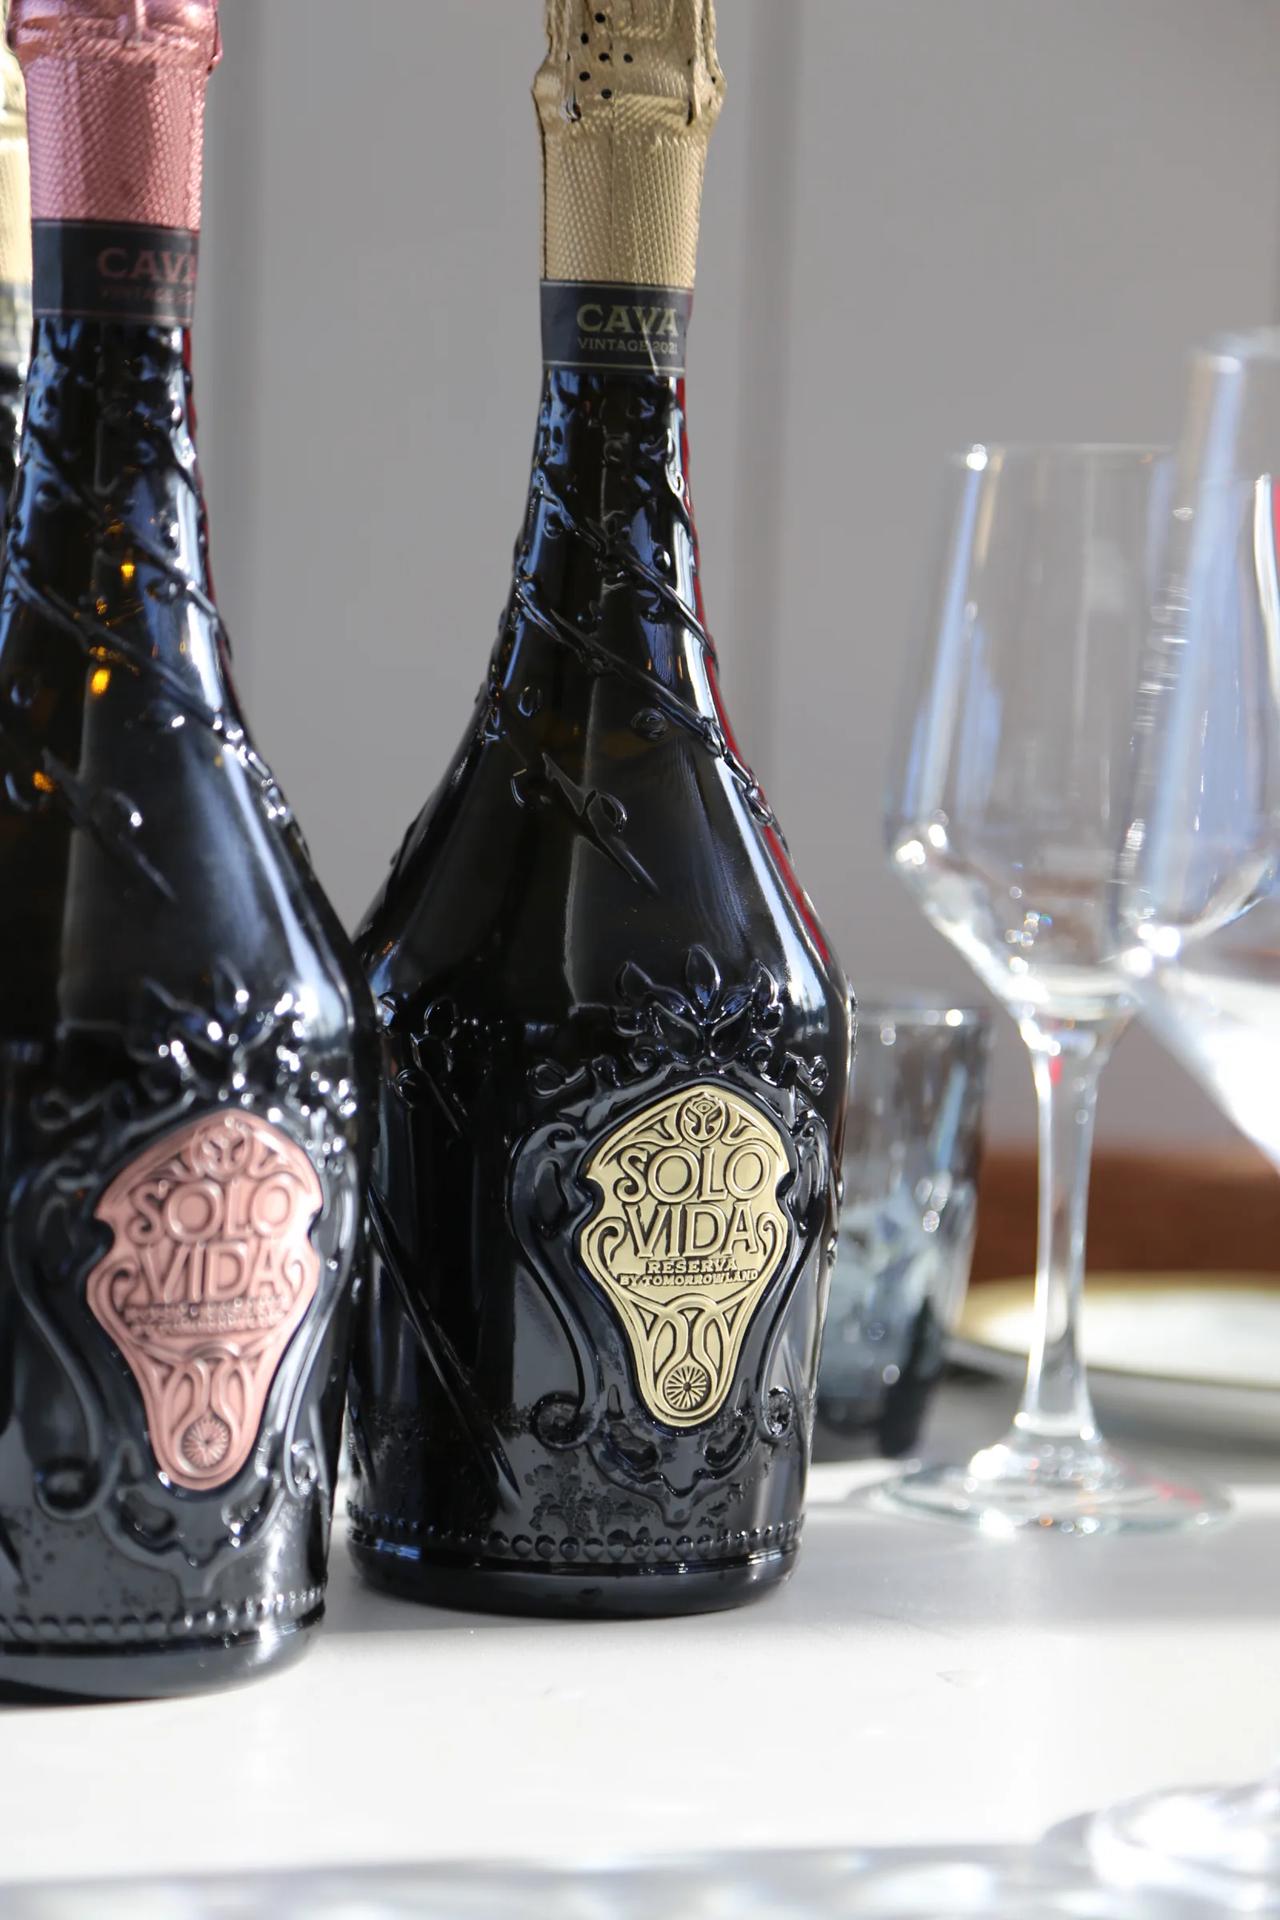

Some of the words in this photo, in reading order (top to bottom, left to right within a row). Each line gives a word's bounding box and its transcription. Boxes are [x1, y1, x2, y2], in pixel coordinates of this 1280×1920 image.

[577, 303, 679, 337] CAVA
[577, 336, 649, 353] VINTAGE
[613, 1143, 770, 1203] SOLO
[127, 1172, 297, 1245] SOLO
[624, 1200, 760, 1258] VIDA
[136, 1239, 289, 1303] VIDA
[640, 1269, 759, 1288] TOMORROWLAND
[646, 1256, 738, 1274] RESERVA
